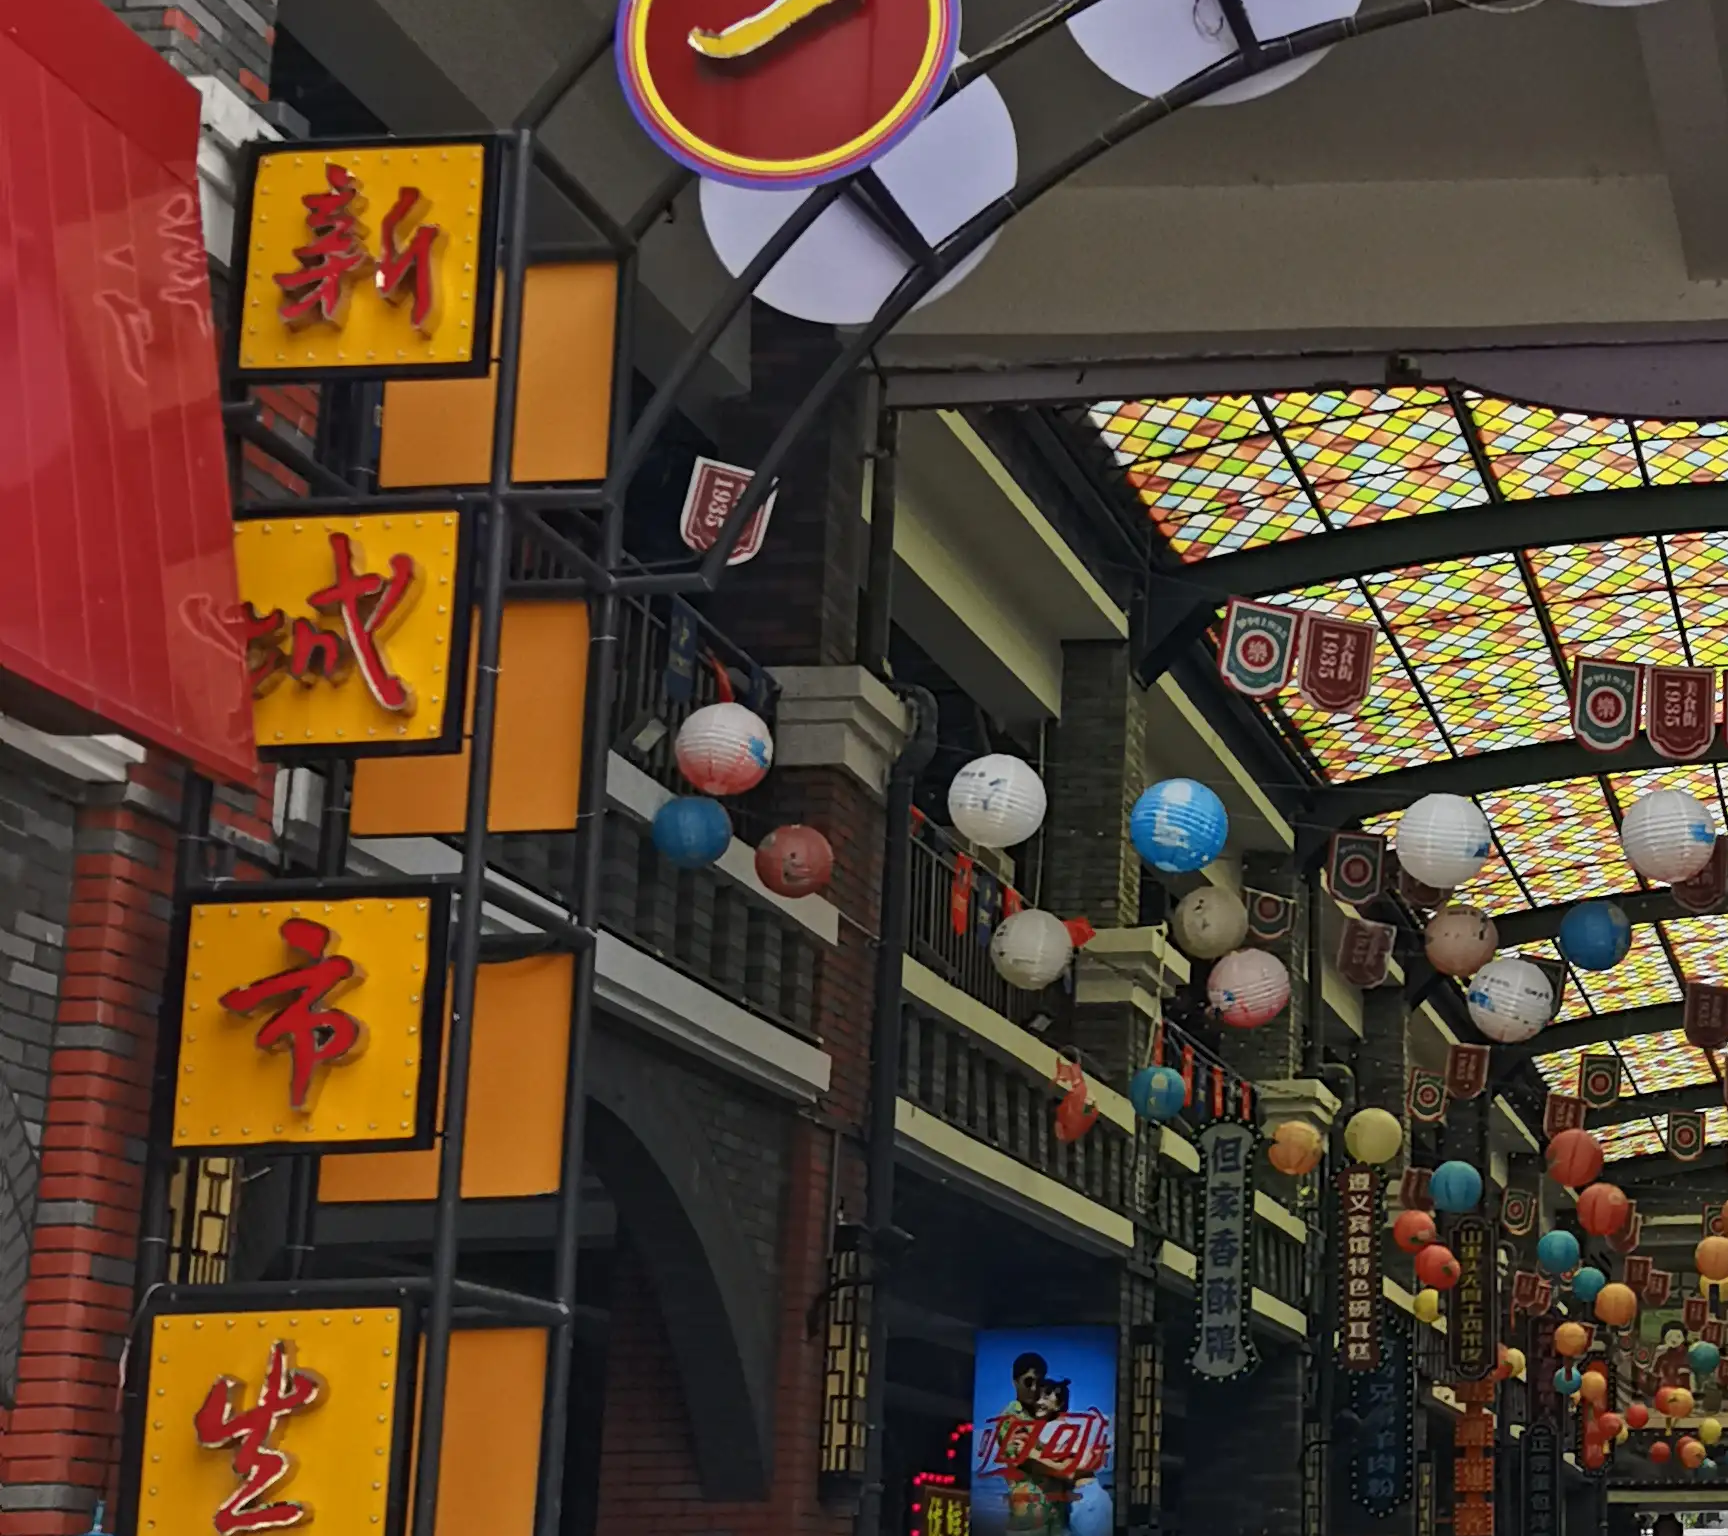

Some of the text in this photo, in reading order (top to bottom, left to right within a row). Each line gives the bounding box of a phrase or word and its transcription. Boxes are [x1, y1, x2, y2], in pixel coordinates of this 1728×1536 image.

[1664, 679, 1683, 728] 1935
[1204, 1135, 1243, 1365] 但家香酥鸭
